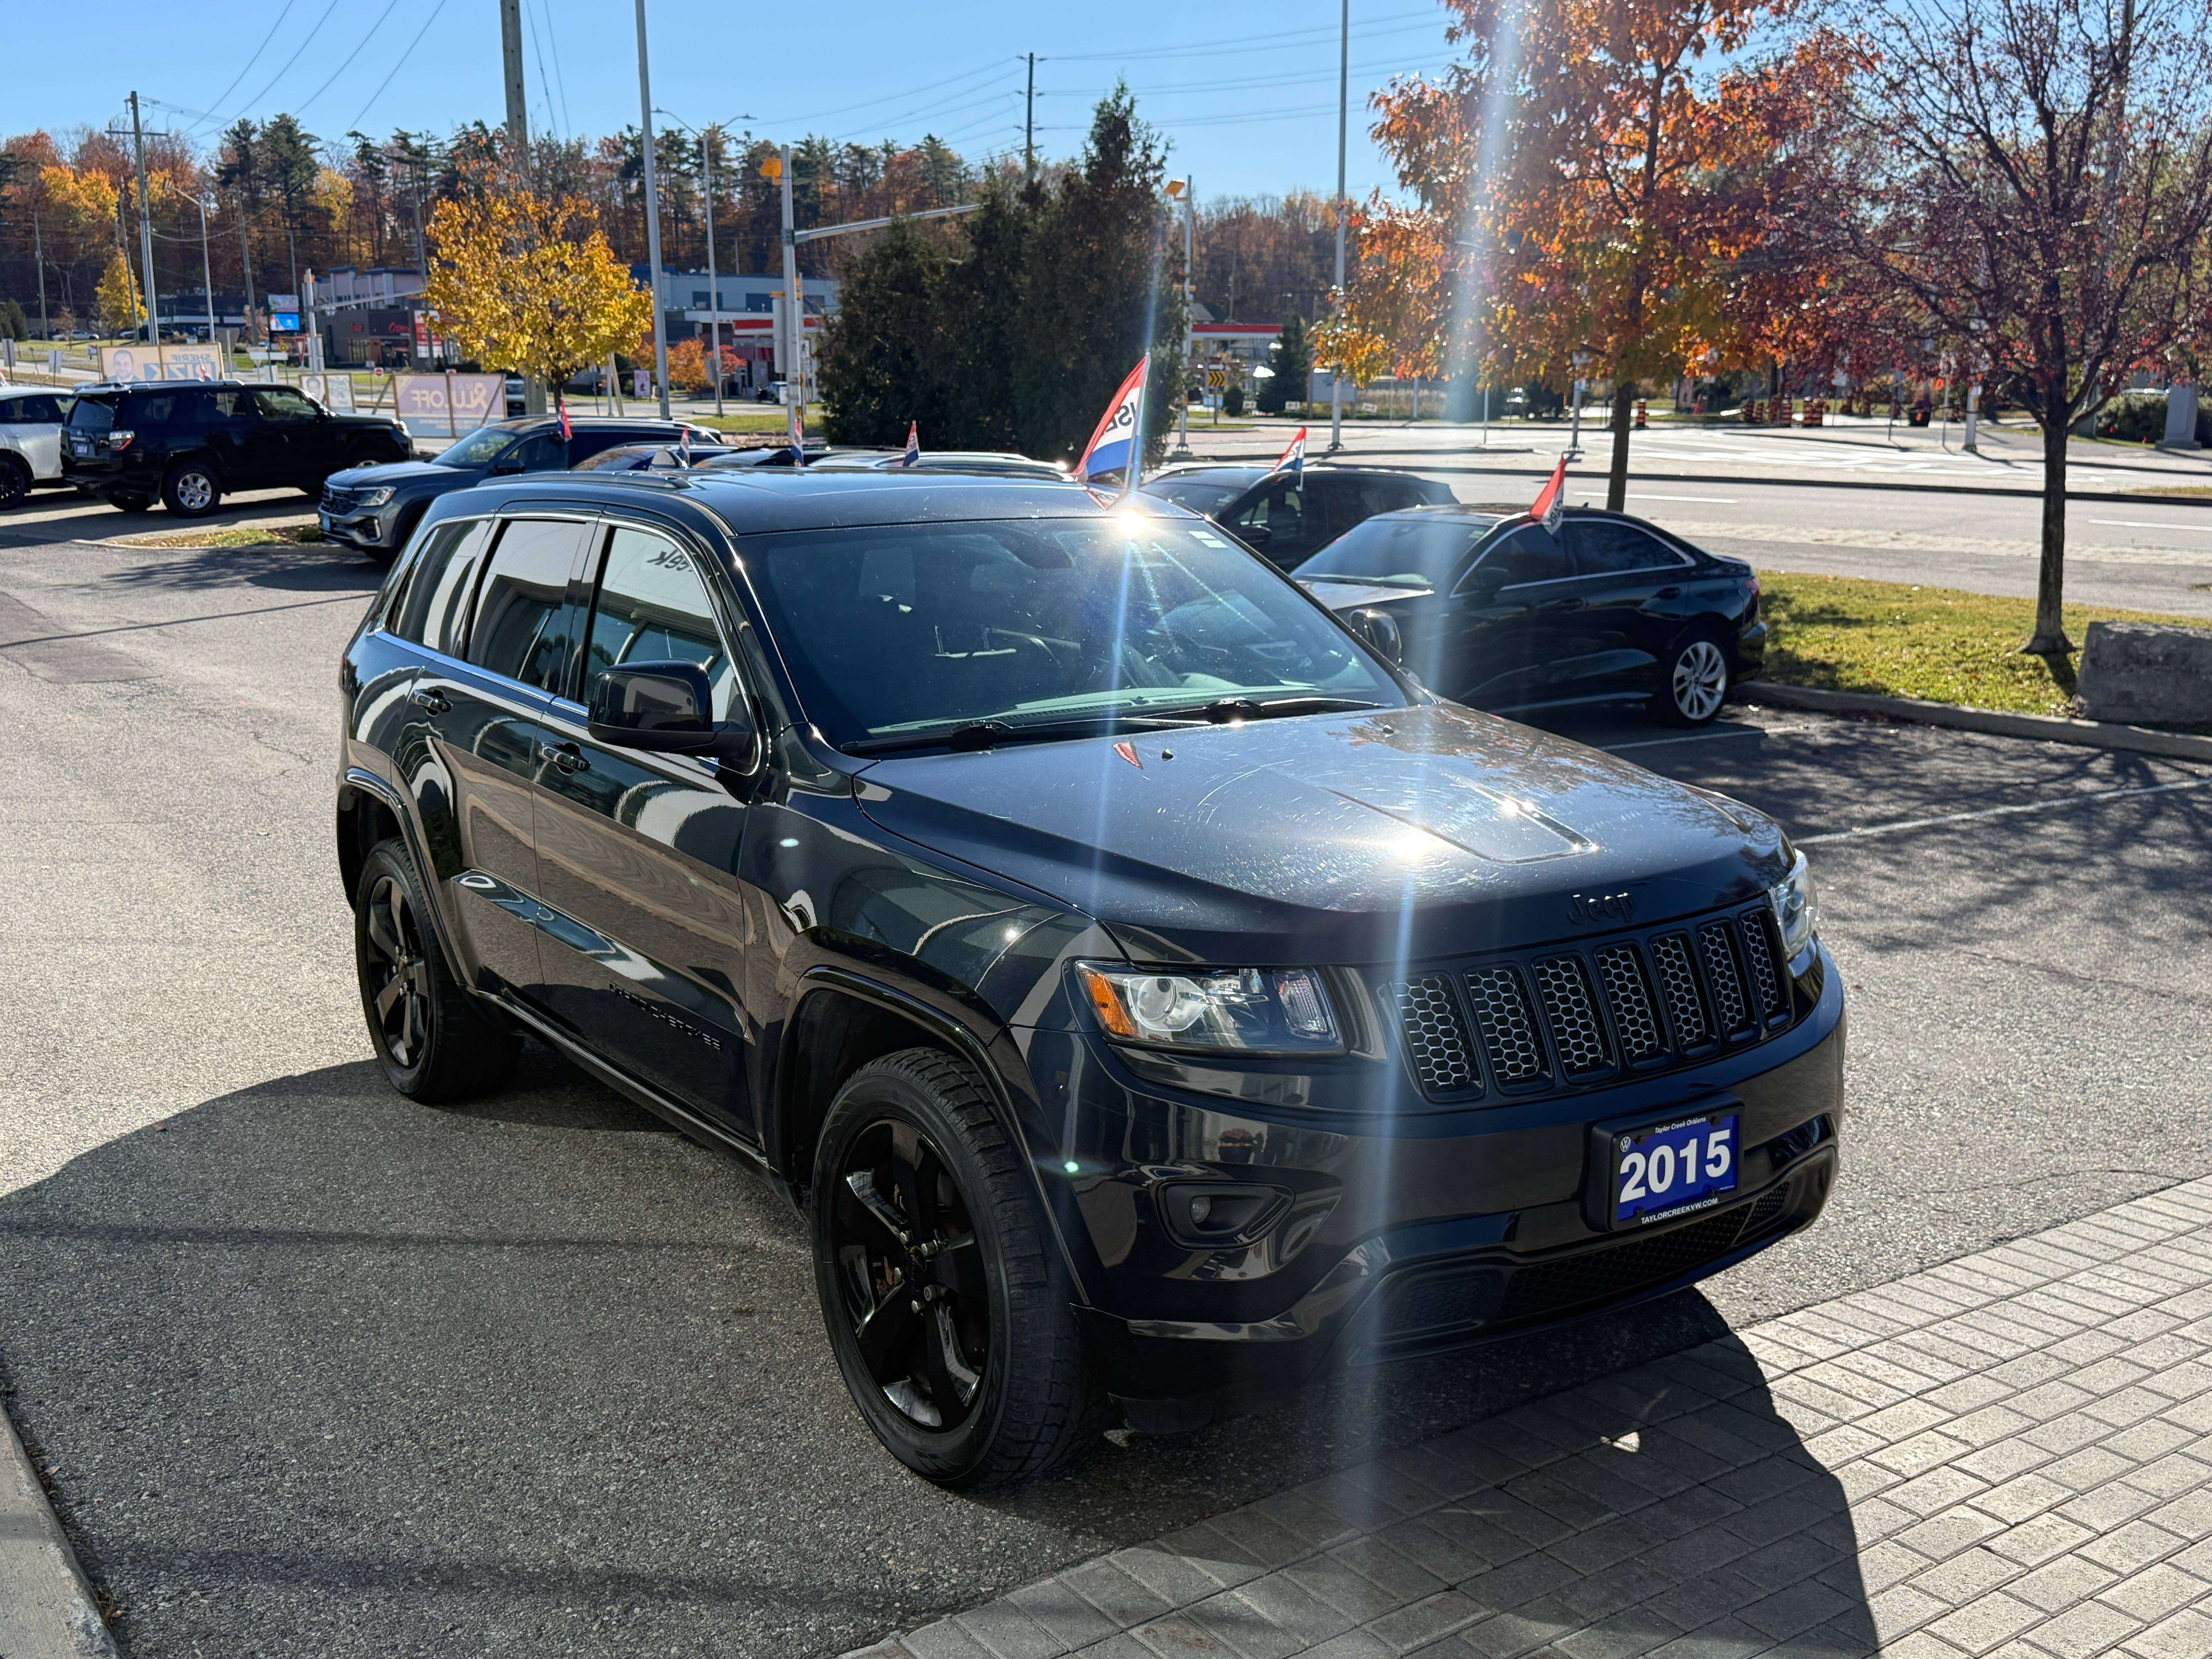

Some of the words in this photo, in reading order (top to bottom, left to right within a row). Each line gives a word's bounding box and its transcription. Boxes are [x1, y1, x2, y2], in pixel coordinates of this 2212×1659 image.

[1568, 892, 1634, 926] Jeep
[1654, 1125, 1670, 1134] Taylor
[1671, 1121, 1685, 1129] Creek
[1620, 1129, 1731, 1203] 2015
[1641, 1197, 1718, 1224] TAYLORCREEKVW.COM
